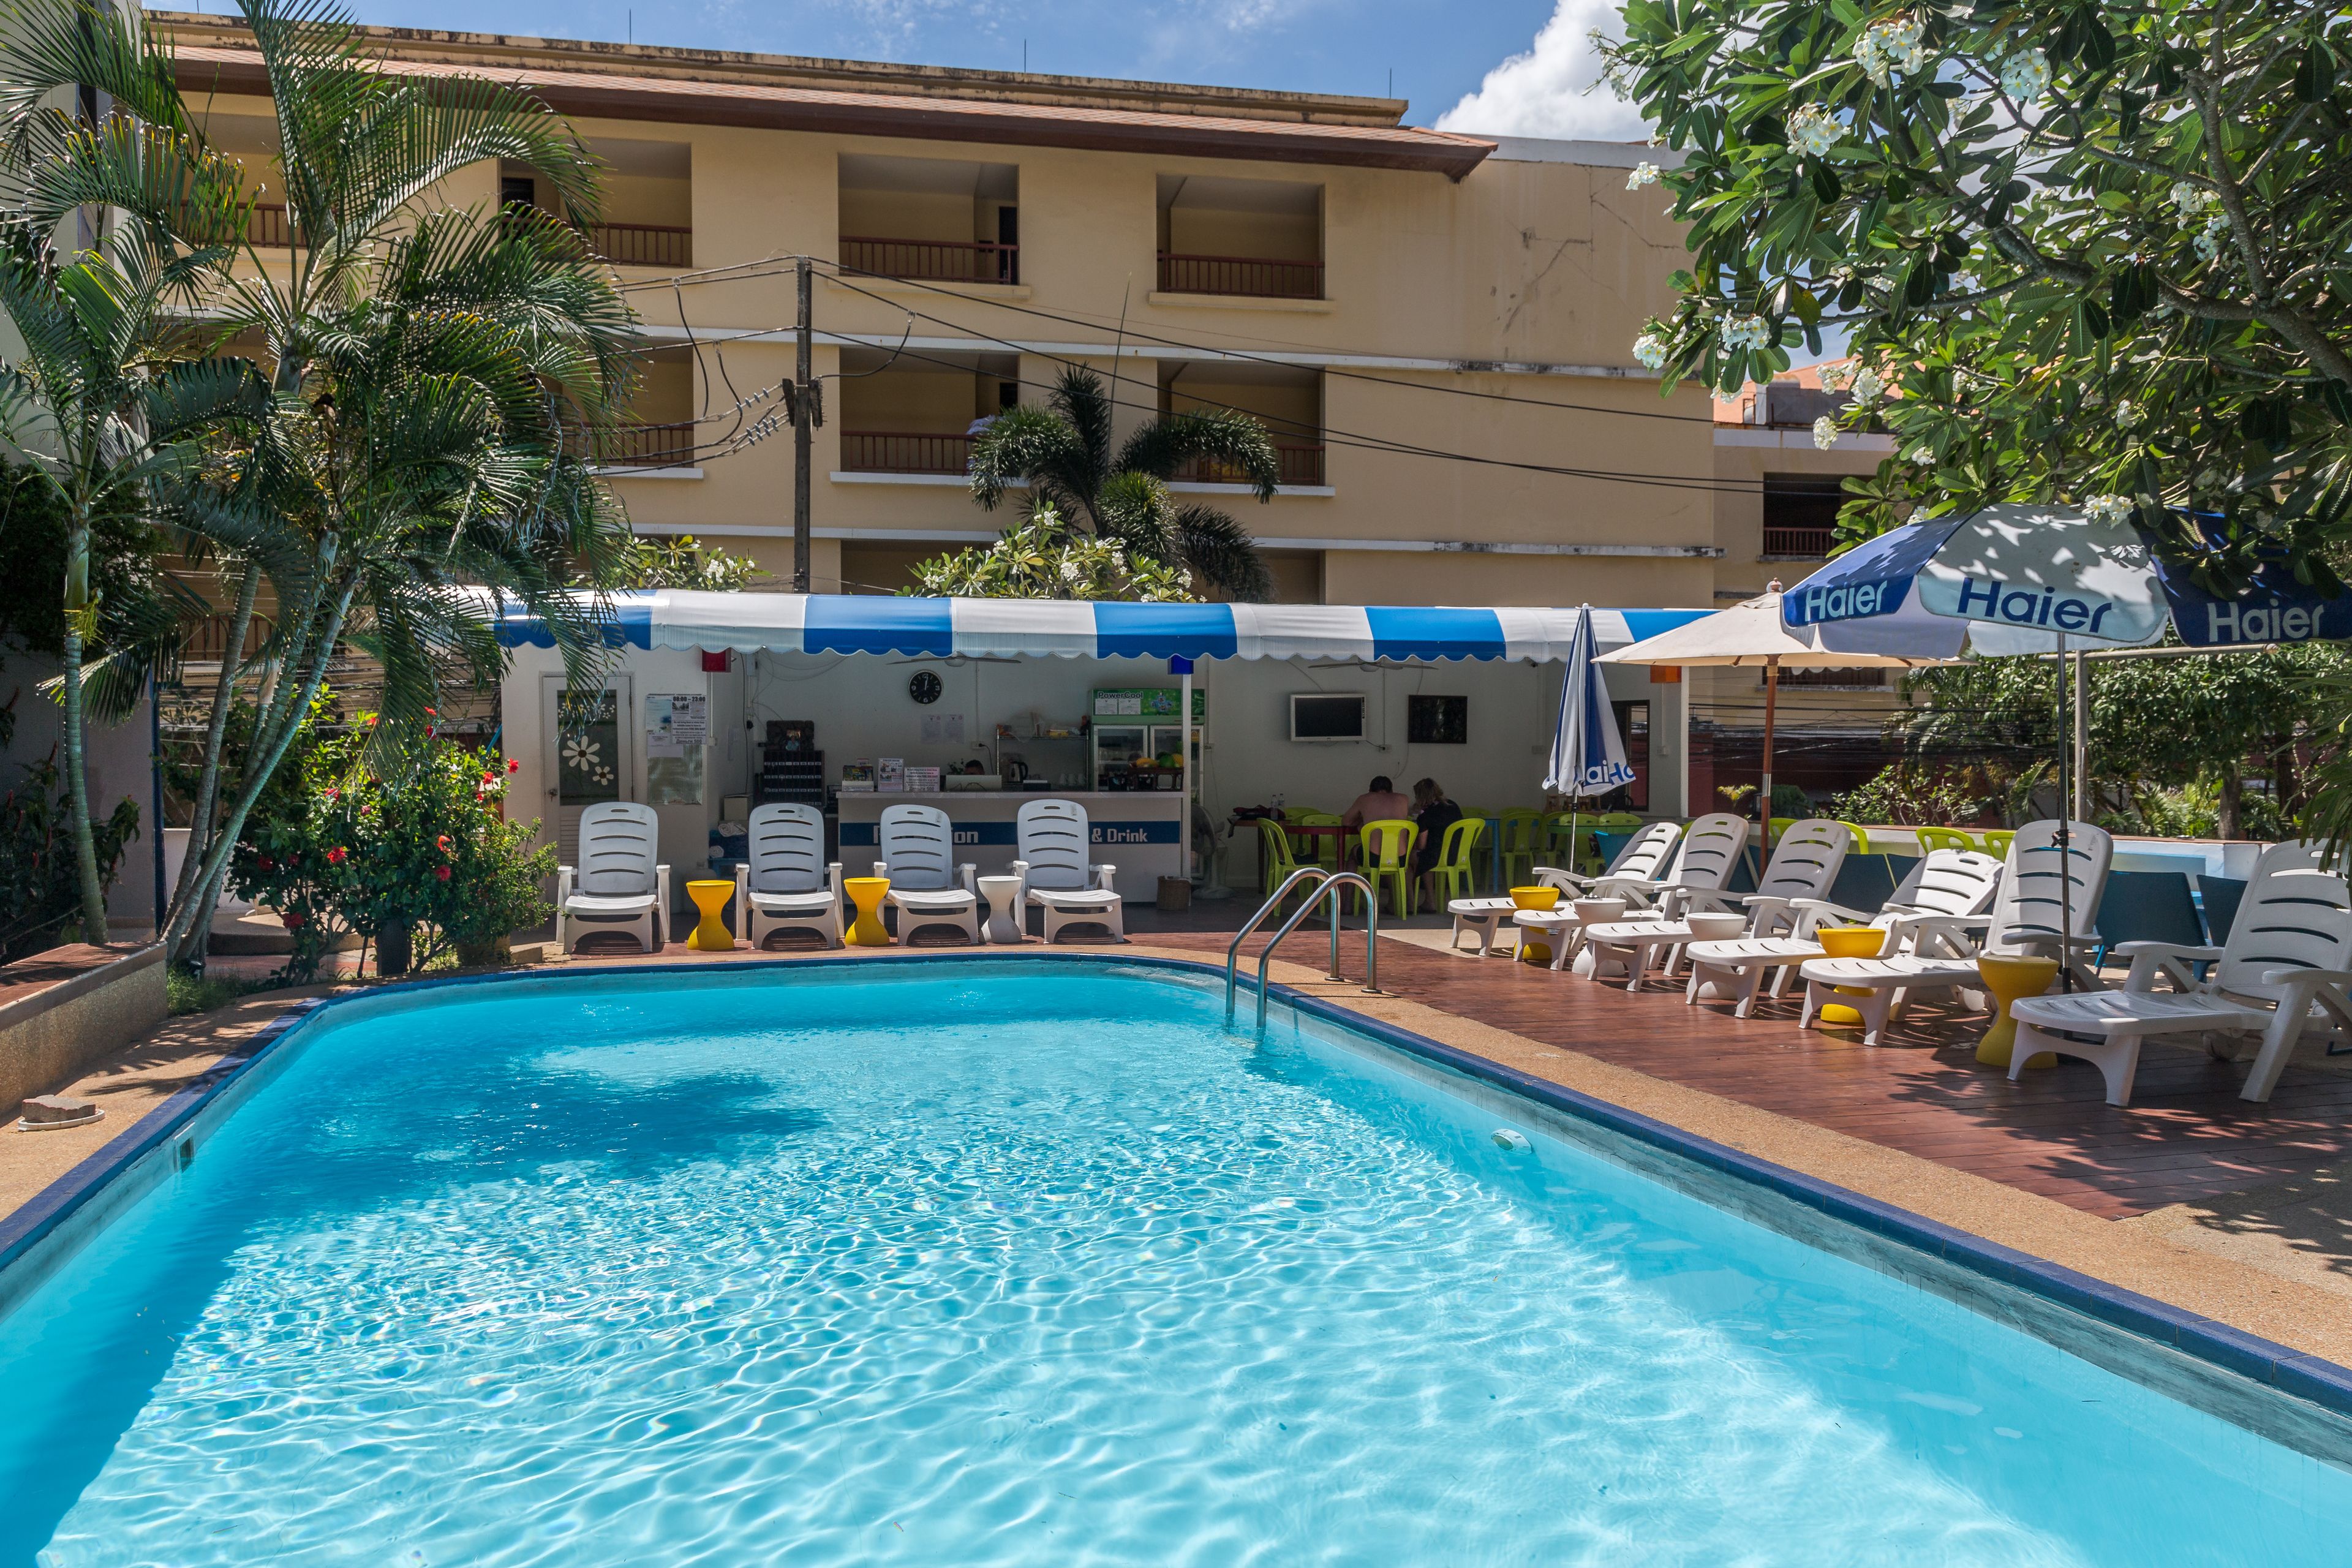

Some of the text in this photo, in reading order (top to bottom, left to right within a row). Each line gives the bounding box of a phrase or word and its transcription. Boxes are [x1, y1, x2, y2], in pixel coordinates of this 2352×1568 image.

[1804, 579, 1887, 622] Haier
[1957, 578, 2112, 633] Haier
[2207, 598, 2324, 642] Haier
[1091, 828, 1102, 842] &
[1107, 828, 1148, 842] Drink
